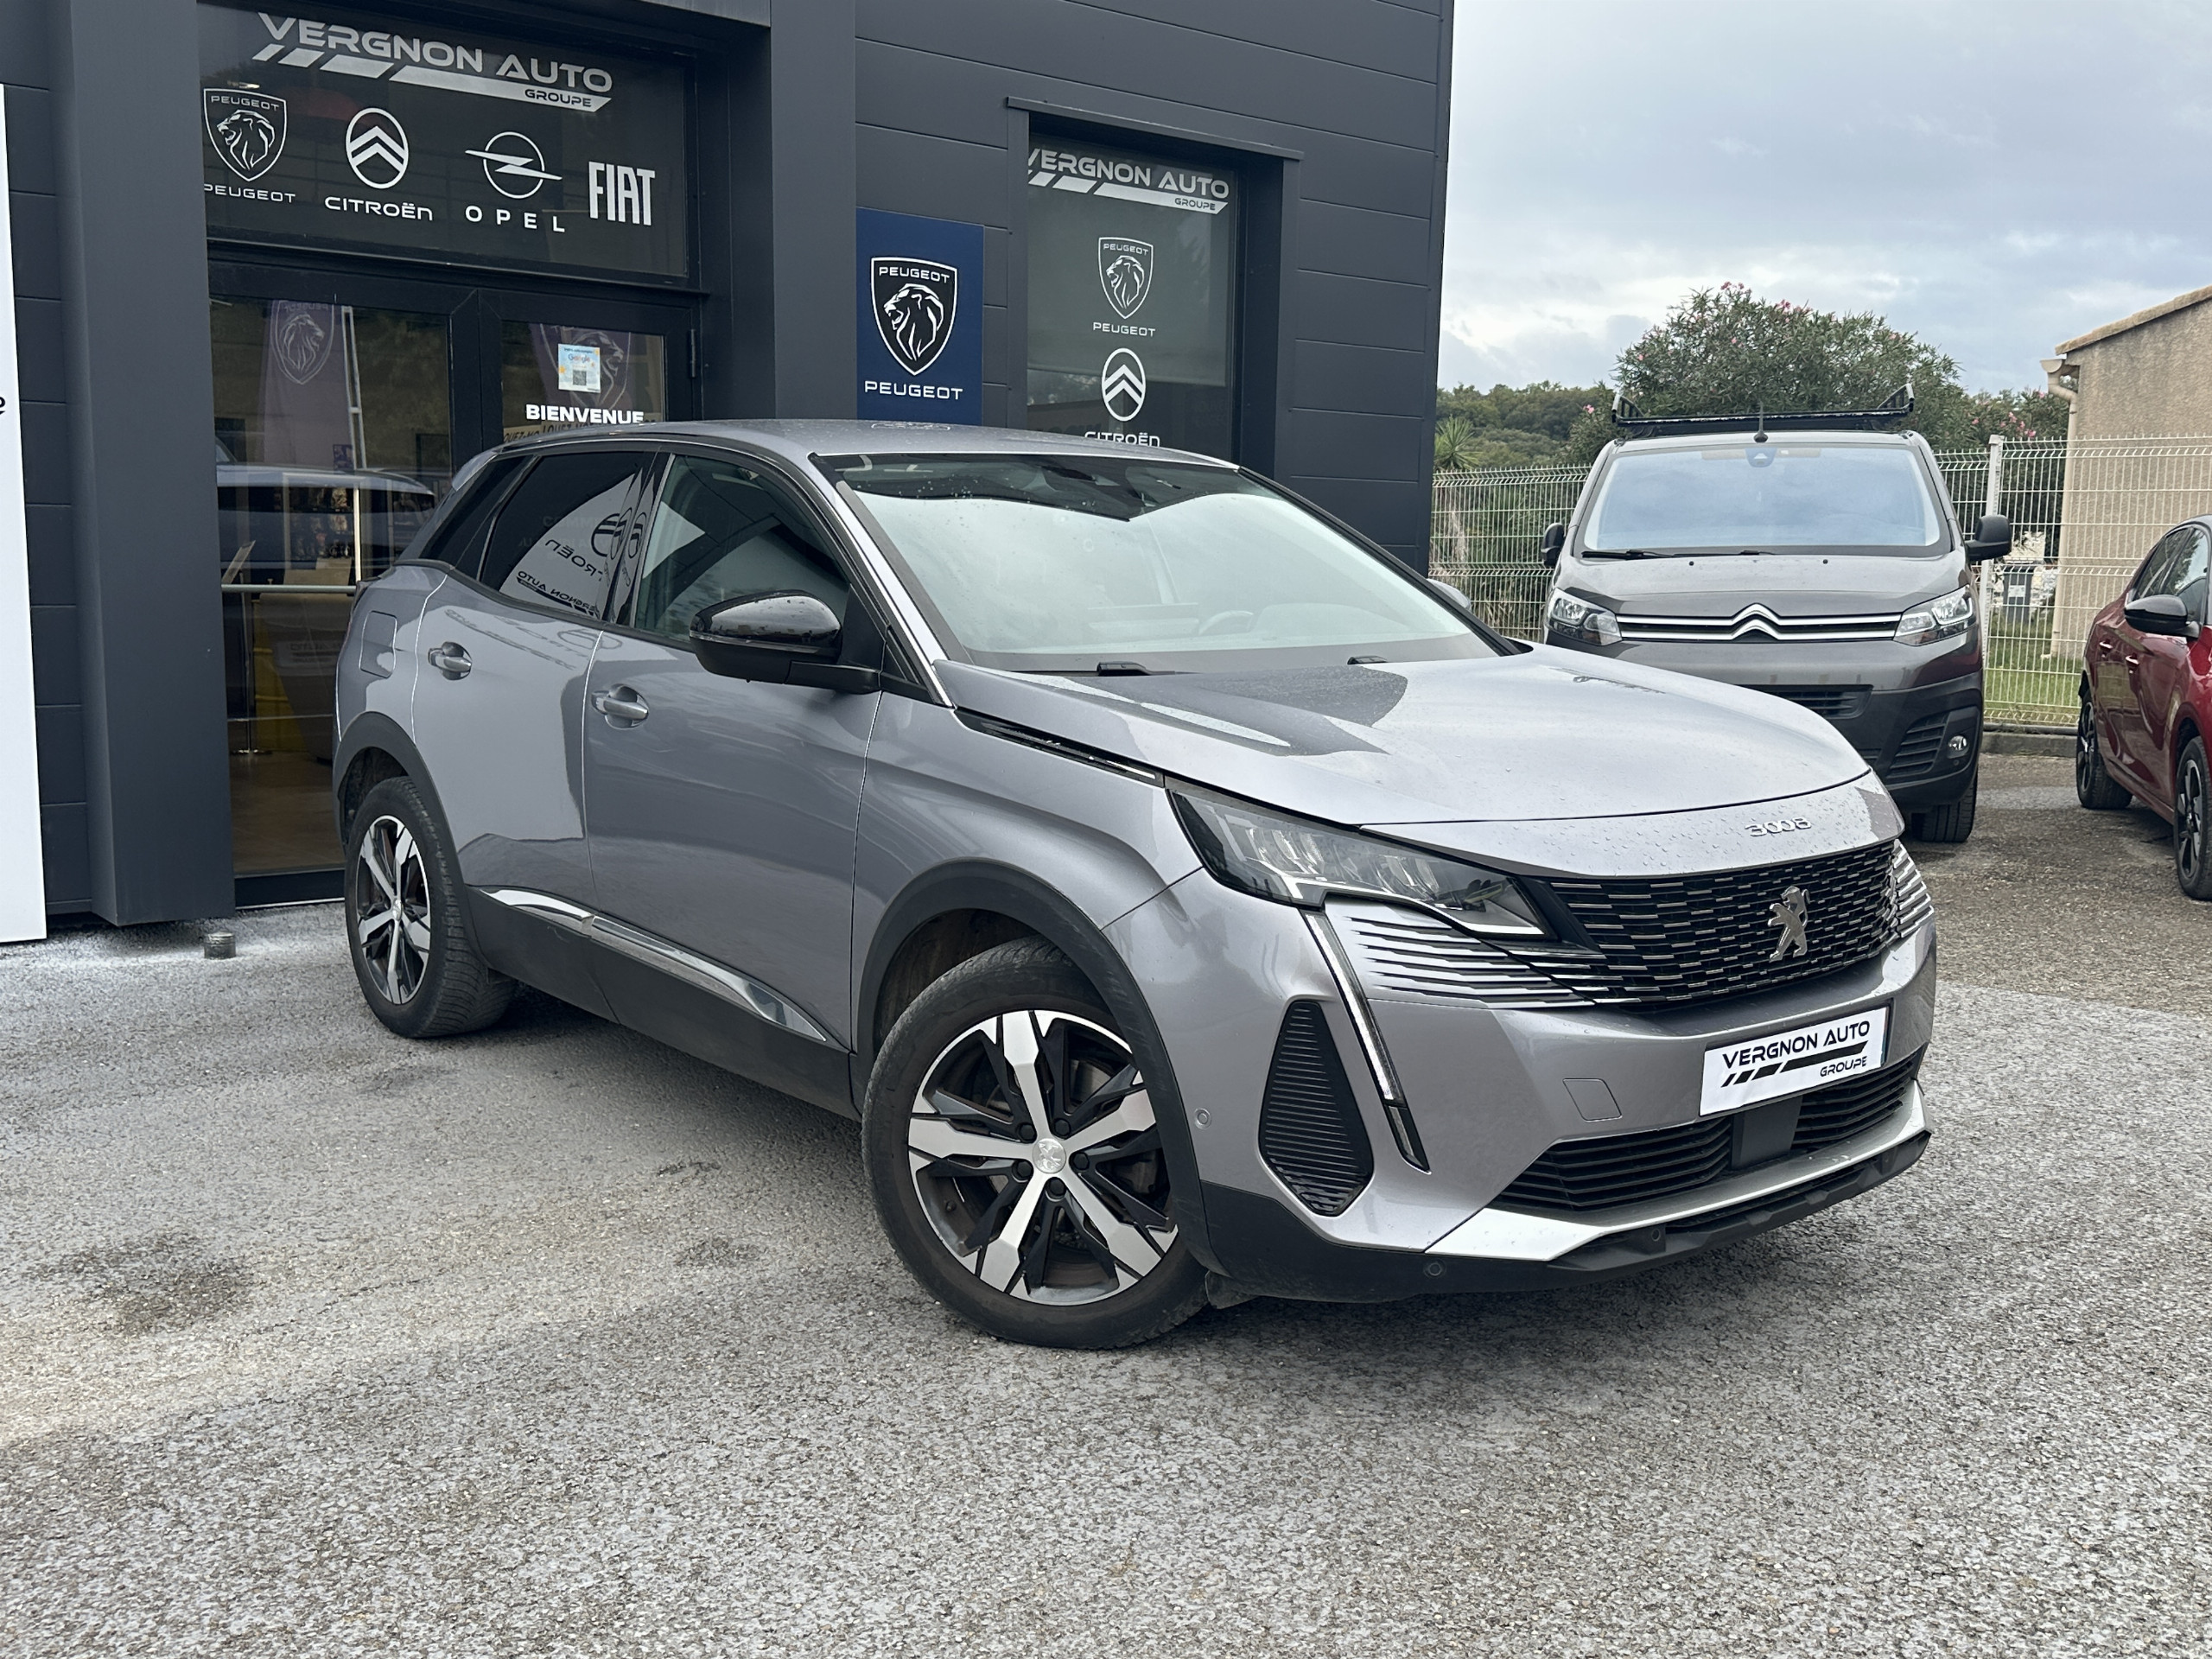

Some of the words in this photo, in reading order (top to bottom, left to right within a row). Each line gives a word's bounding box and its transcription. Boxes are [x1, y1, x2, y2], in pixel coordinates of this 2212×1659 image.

[257, 12, 484, 73] VERGNON
[495, 54, 613, 92] AUTO
[210, 95, 280, 111] PEUGEOT
[524, 88, 593, 108] GROUPE
[588, 161, 656, 226] FIAT
[1158, 171, 1230, 200] AUTO
[1174, 197, 1216, 211] GROUPE
[465, 205, 566, 232] OPEL
[1103, 243, 1149, 256] PEUGEOT
[878, 266, 950, 284] PEUGEOT
[1093, 321, 1156, 337] PEUGEOT
[864, 380, 963, 401] PEUGEOT
[525, 404, 644, 424] BIENVENUE
[1745, 817, 1812, 836] 3008
[1722, 1032, 1818, 1069] VERGNON
[1823, 1020, 1871, 1047] AUTO
[1820, 1055, 1867, 1077] GROUPE
